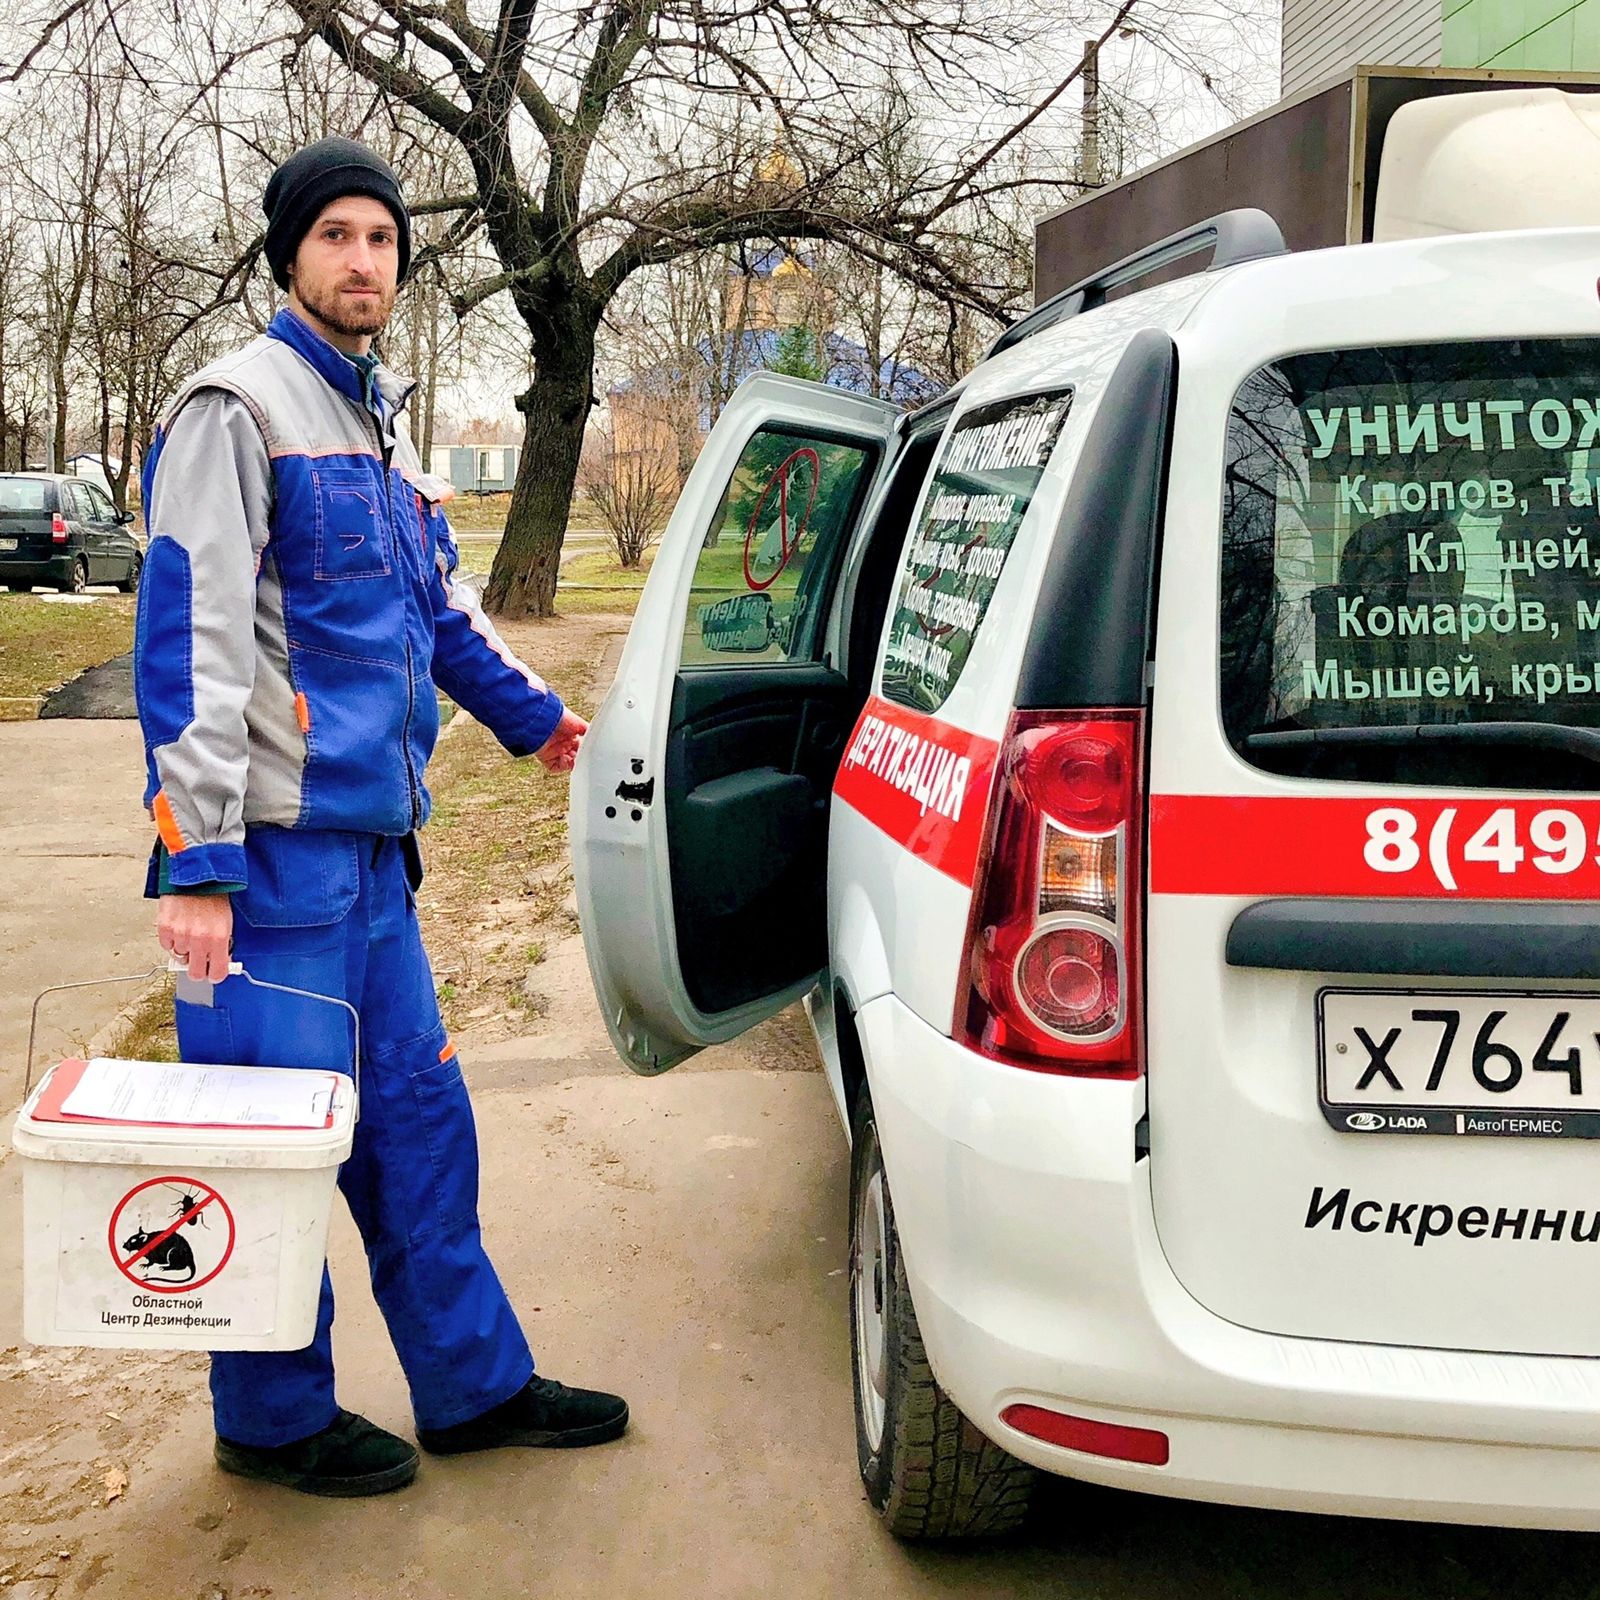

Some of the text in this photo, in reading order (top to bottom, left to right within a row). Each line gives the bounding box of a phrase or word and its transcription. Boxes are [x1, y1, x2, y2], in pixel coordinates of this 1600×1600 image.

[940, 410, 1059, 475] УНИЧТОЖЕНИЕ
[963, 494, 1016, 532] муравьев
[1339, 474, 1600, 517] Клопов, та
[1407, 526, 1600, 577] Клщей,
[1337, 596, 1560, 645] Комаров,
[1302, 654, 1495, 704] Мышей,
[844, 714, 972, 823] ДЕРАТИЗАЦИЯ
[1363, 808, 1600, 890] 8(49
[1388, 1116, 1428, 1129] LADA
[1467, 1118, 1563, 1134] АвтоГЕРМЕС
[1305, 1186, 1600, 1247] Искренни
[101, 1311, 232, 1328] Центр Дезинфекции
[132, 1295, 203, 1310] Областной
